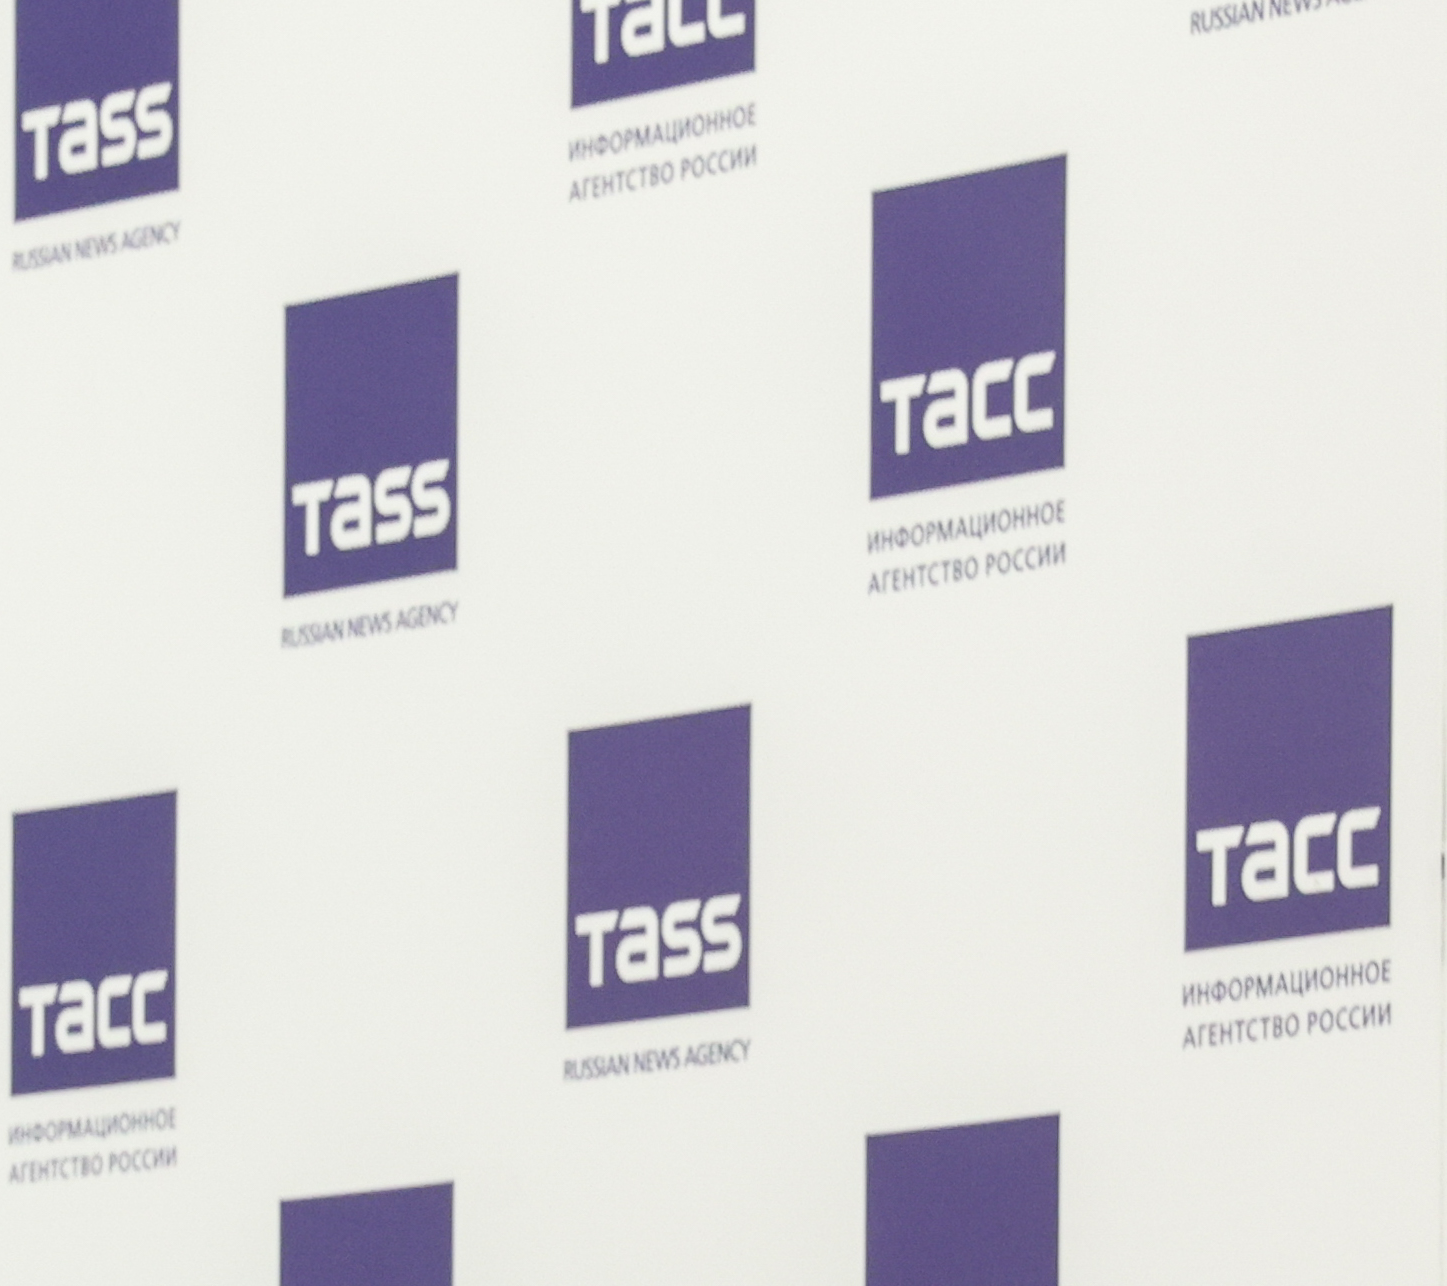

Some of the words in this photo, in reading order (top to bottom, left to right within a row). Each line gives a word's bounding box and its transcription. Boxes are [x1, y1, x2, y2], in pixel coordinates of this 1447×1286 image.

[1190, 0, 1264, 35] RUSSIAN
[568, 102, 757, 163] ИНФОРМАЦИОННОЕ
[569, 160, 674, 203] АГЕНТСТВО
[680, 145, 758, 186] РОССИИ
[12, 240, 72, 272] RUSSIAN
[75, 231, 118, 261] NEWS
[121, 220, 181, 254] AGENCY
[867, 499, 1066, 556] ИНФОРМАЦИОННОЕ
[868, 553, 978, 597] АГЕНТСТВО
[985, 541, 1068, 580] РОССИИ
[281, 617, 344, 650] RUSSIAN
[347, 610, 393, 640] NEWS
[397, 600, 459, 634] AGENCY
[1181, 958, 1393, 1009] ИНФОРМАЦИОННОЕ
[1182, 1011, 1301, 1051] АГЕНТСТВО
[1307, 1003, 1393, 1037] РОССИИ
[563, 1053, 629, 1082] RUSSIAN
[633, 1046, 682, 1075] NEWS
[685, 1038, 752, 1071] AGENCY
[8, 1106, 177, 1147] ИНФОРМАЦИОННОЕ
[9, 1153, 103, 1184] АГЕНТСТВО
[108, 1145, 178, 1177] РОССИИ
